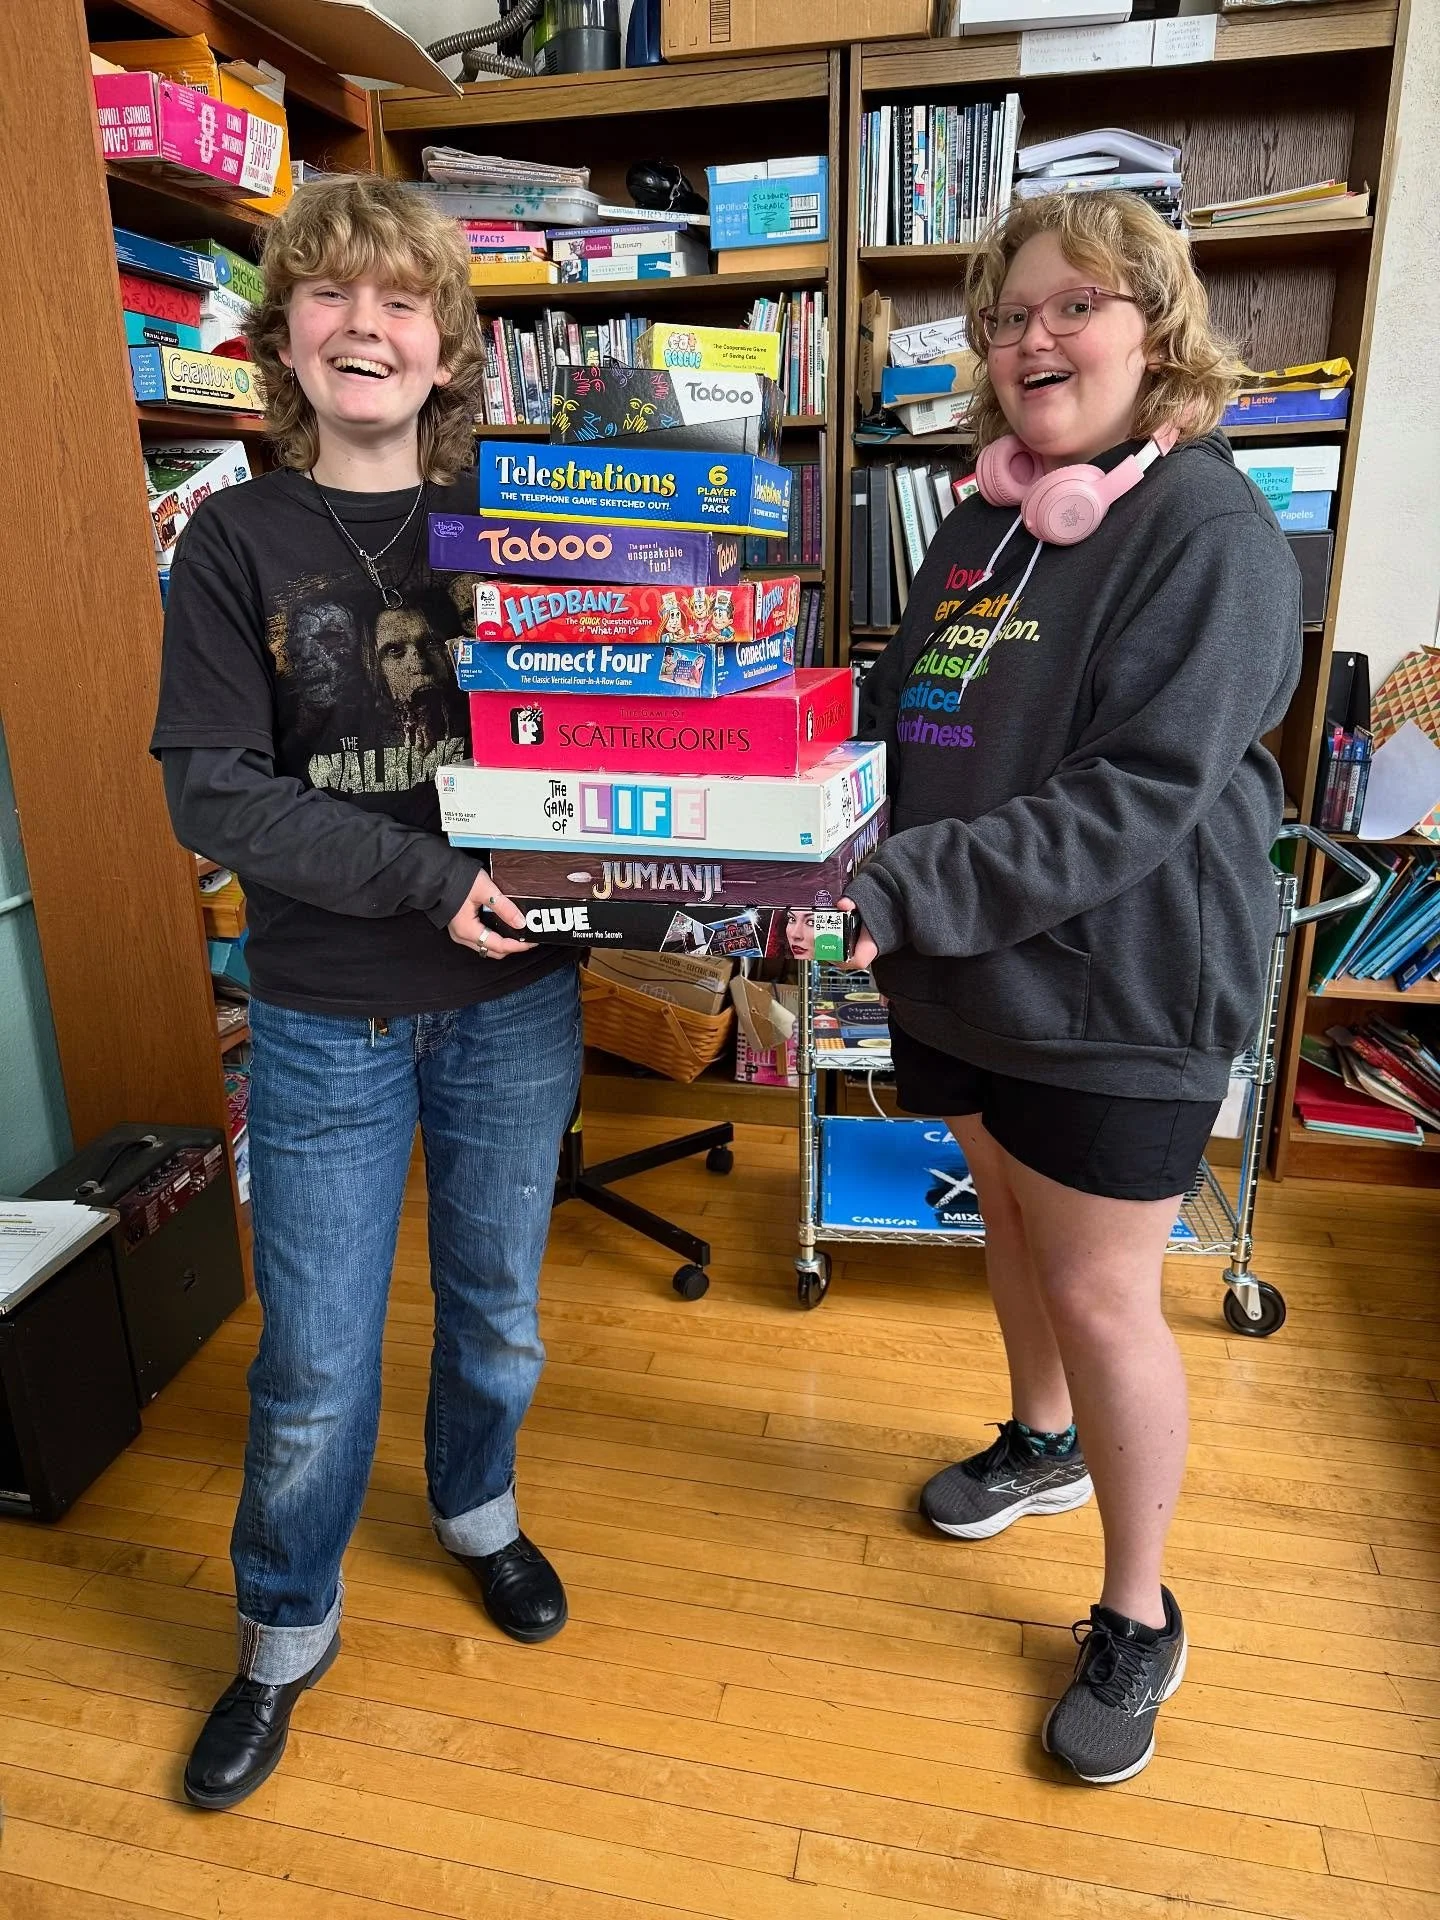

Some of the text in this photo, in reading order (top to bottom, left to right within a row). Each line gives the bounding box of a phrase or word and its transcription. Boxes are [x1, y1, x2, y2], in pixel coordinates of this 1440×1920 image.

[122, 105, 151, 125] BONUS!
[480, 235, 505, 243] FACTS
[585, 241, 642, 252] Children's Dictionary
[684, 382, 754, 405] Taboo
[1252, 396, 1277, 404] Letter
[495, 455, 678, 498] Telestrations
[709, 465, 728, 486] 6
[697, 487, 737, 497] PLAYER
[500, 492, 671, 511] THE TELEPHONE GAME SKETCHED OUT!
[704, 496, 728, 504] FAMILY
[701, 504, 730, 514] PACK
[1281, 511, 1314, 521] Papeles
[478, 528, 612, 565] Taboo
[628, 546, 683, 562] unspeakable
[649, 558, 671, 573] fun!
[505, 590, 628, 637] HEDBANZ
[566, 616, 652, 628] The QUICK Question Game
[587, 626, 612, 636] "What
[613, 627, 626, 635] Am
[506, 644, 653, 674] Connect Four
[736, 641, 766, 667] Connect
[521, 675, 531, 683] The
[532, 676, 550, 684] Classic
[551, 676, 572, 685] Vertical
[615, 678, 632, 686] Game
[340, 736, 359, 751] THE
[558, 724, 750, 752] SCATTERGORIES
[442, 776, 455, 787] MB
[583, 786, 705, 837] LIFE
[592, 861, 723, 903] JUMANJI
[526, 907, 590, 933] CLUE
[573, 930, 594, 938] Discover
[606, 931, 623, 939] Secrets
[852, 1216, 918, 1226] CANSON
